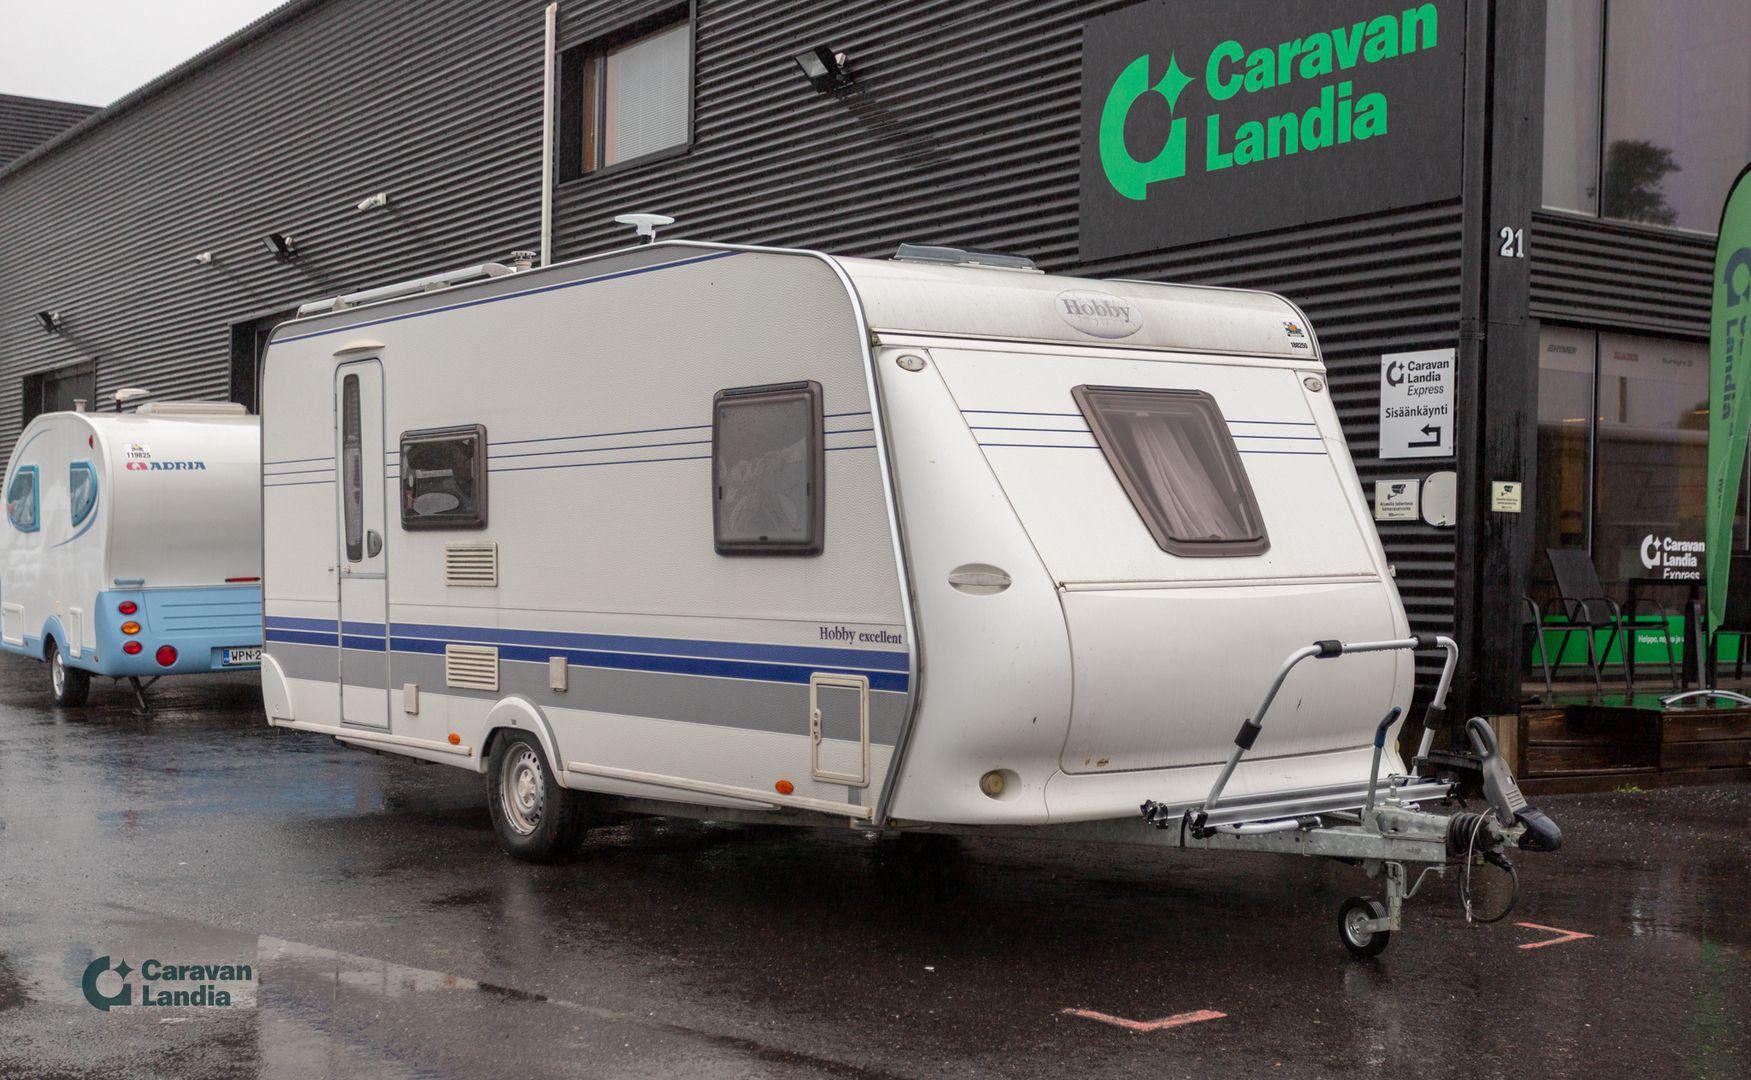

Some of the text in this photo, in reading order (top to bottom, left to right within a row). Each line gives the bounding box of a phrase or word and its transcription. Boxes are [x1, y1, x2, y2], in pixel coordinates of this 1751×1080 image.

[1205, 2, 1438, 101] Caravan
[1205, 82, 1388, 172] Landia
[1500, 226, 1524, 258] 21
[1061, 298, 1130, 323] Hobby
[1407, 360, 1450, 372] Caravan
[1407, 372, 1441, 384] Landia
[1407, 384, 1444, 397] Express
[1385, 404, 1448, 419] Sisäänkäynti
[149, 461, 206, 471] ADRIA
[1663, 537, 1705, 552] Caravan
[1663, 552, 1697, 567] Landia
[819, 626, 902, 645] Hobby excellent
